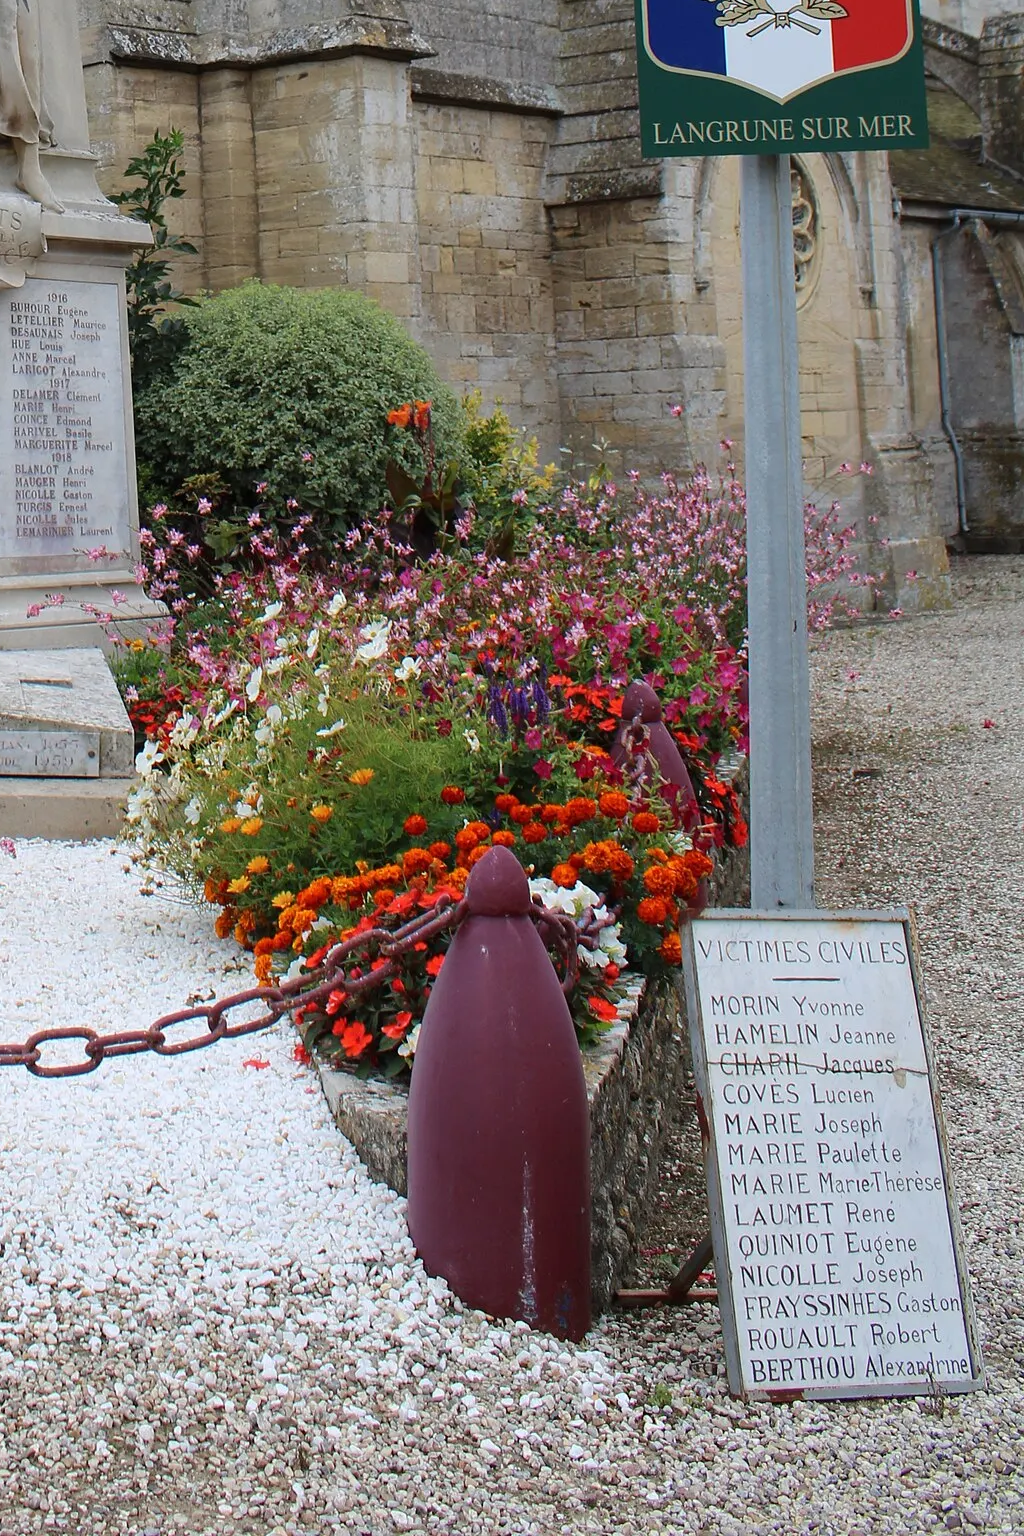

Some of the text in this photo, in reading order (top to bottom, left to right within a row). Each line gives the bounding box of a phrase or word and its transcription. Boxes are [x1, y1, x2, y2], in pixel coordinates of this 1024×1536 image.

[652, 114, 915, 144] LANGRUNE SUR MER
[0, 232, 15, 243] LA
[48, 293, 68, 303] 1916
[10, 302, 50, 314] BUHOUR
[11, 314, 106, 330] LETELLIER Maurice
[11, 327, 101, 343] DESAUNAIS Joseph
[11, 339, 63, 352] HUE Louis
[13, 352, 76, 365] ANNE Marcel
[62, 367, 106, 379] Alexandre
[49, 379, 70, 389] 1917
[13, 389, 59, 400] DELAMER
[13, 401, 75, 415] MARIE Henri
[14, 415, 91, 426] COINCE Edmond
[14, 427, 92, 439] HARIVEL Basile
[15, 440, 113, 451] MARGUERITE Marcel
[52, 453, 71, 463] 1918
[15, 464, 94, 475] BLANLOT André
[15, 478, 86, 488] MAUGER Henri
[16, 490, 93, 500] NICOLLE Gaston
[59, 502, 87, 512] Ernest
[16, 514, 88, 525] NICOLLE Jules
[81, 527, 113, 536] Laurent
[698, 940, 906, 964] VICTIMES CIVILES
[711, 995, 865, 1016] MORIN Yvonne
[715, 1024, 896, 1045] HAMELIN Jeanne
[720, 1052, 895, 1080] CHARIL Jacques
[723, 1079, 874, 1104] COVÈS Lucien
[724, 1112, 883, 1137] MARIE Joseph
[728, 1141, 902, 1165] MARIE Paulette
[731, 1172, 810, 1195] MARIE
[734, 1200, 896, 1226] LAUMET René
[739, 1231, 917, 1265] QUINIOT Eugène
[740, 1261, 923, 1288] NICOLLE Joseph
[744, 1292, 960, 1320] FRAYSSINHES Gaston
[748, 1322, 941, 1351] ROUAULT Robert
[750, 1352, 969, 1382] BERTHOU Alexandrine
